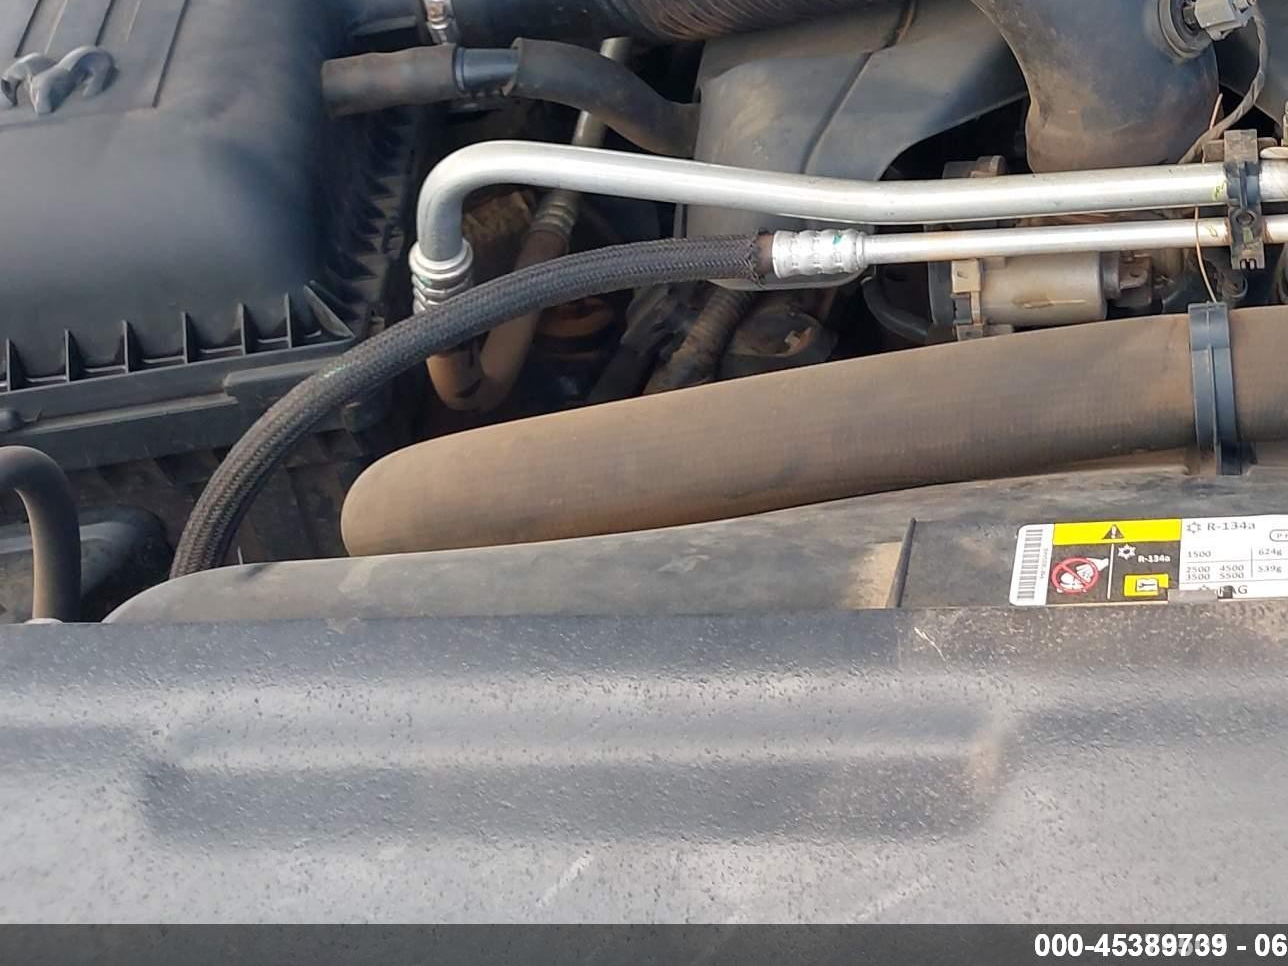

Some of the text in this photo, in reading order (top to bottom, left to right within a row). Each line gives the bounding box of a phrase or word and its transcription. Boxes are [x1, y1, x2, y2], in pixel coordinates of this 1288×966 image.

[1206, 521, 1256, 531] R-134a
[1137, 554, 1171, 563] R-134a
[1187, 550, 1212, 558] 1500
[1186, 564, 1245, 574] 2500 4500
[1186, 572, 1245, 581] 3500 5500
